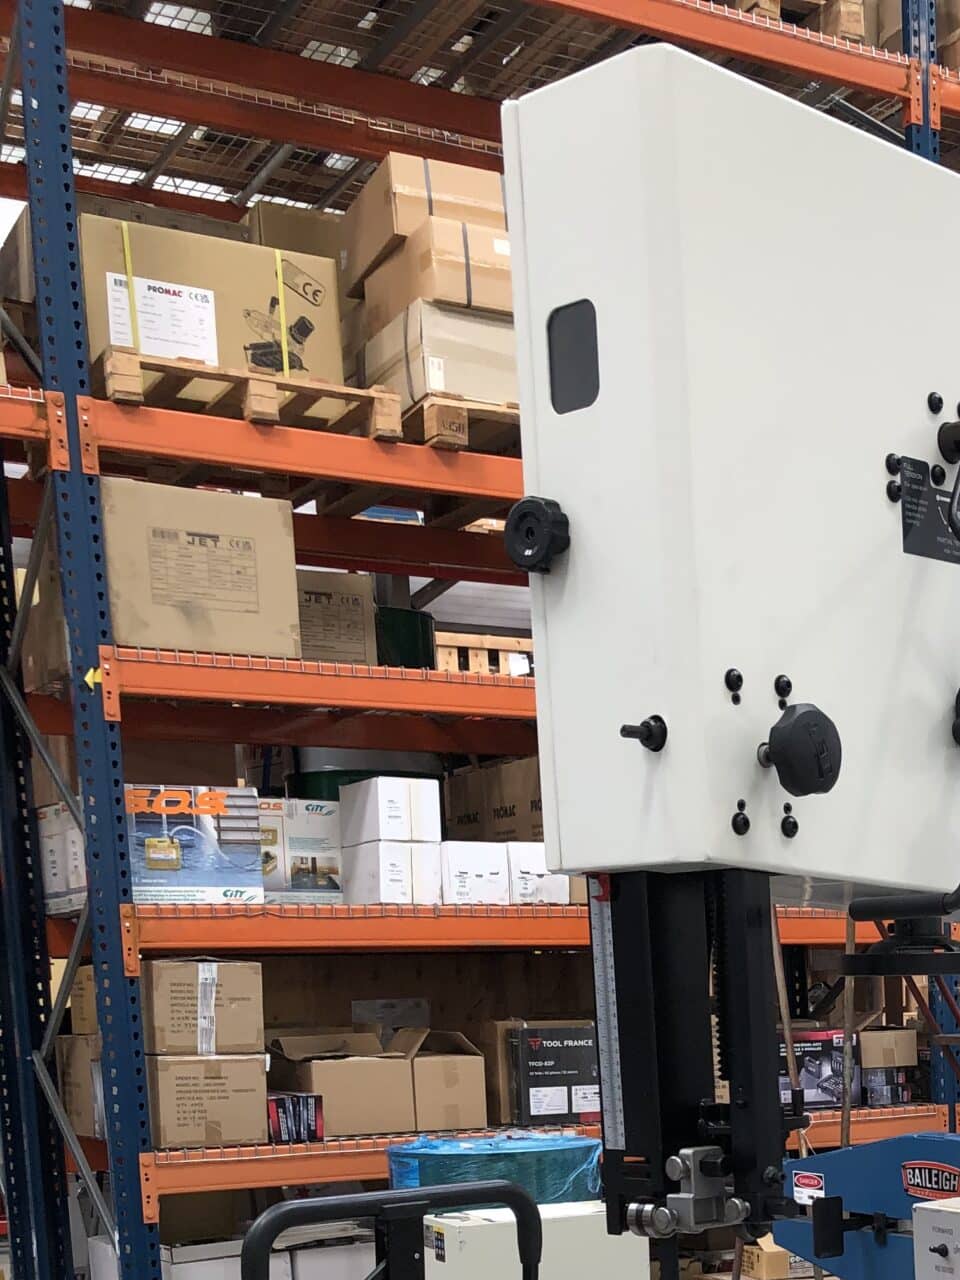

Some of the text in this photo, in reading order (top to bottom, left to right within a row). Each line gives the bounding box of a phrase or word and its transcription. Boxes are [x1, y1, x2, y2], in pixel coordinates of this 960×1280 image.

[147, 284, 183, 298] PROMAC
[185, 535, 220, 548] JET
[303, 593, 333, 604] JET
[542, 1039, 593, 1048] TOOL FRANCE
[907, 1168, 959, 1191] BAILEIGH
